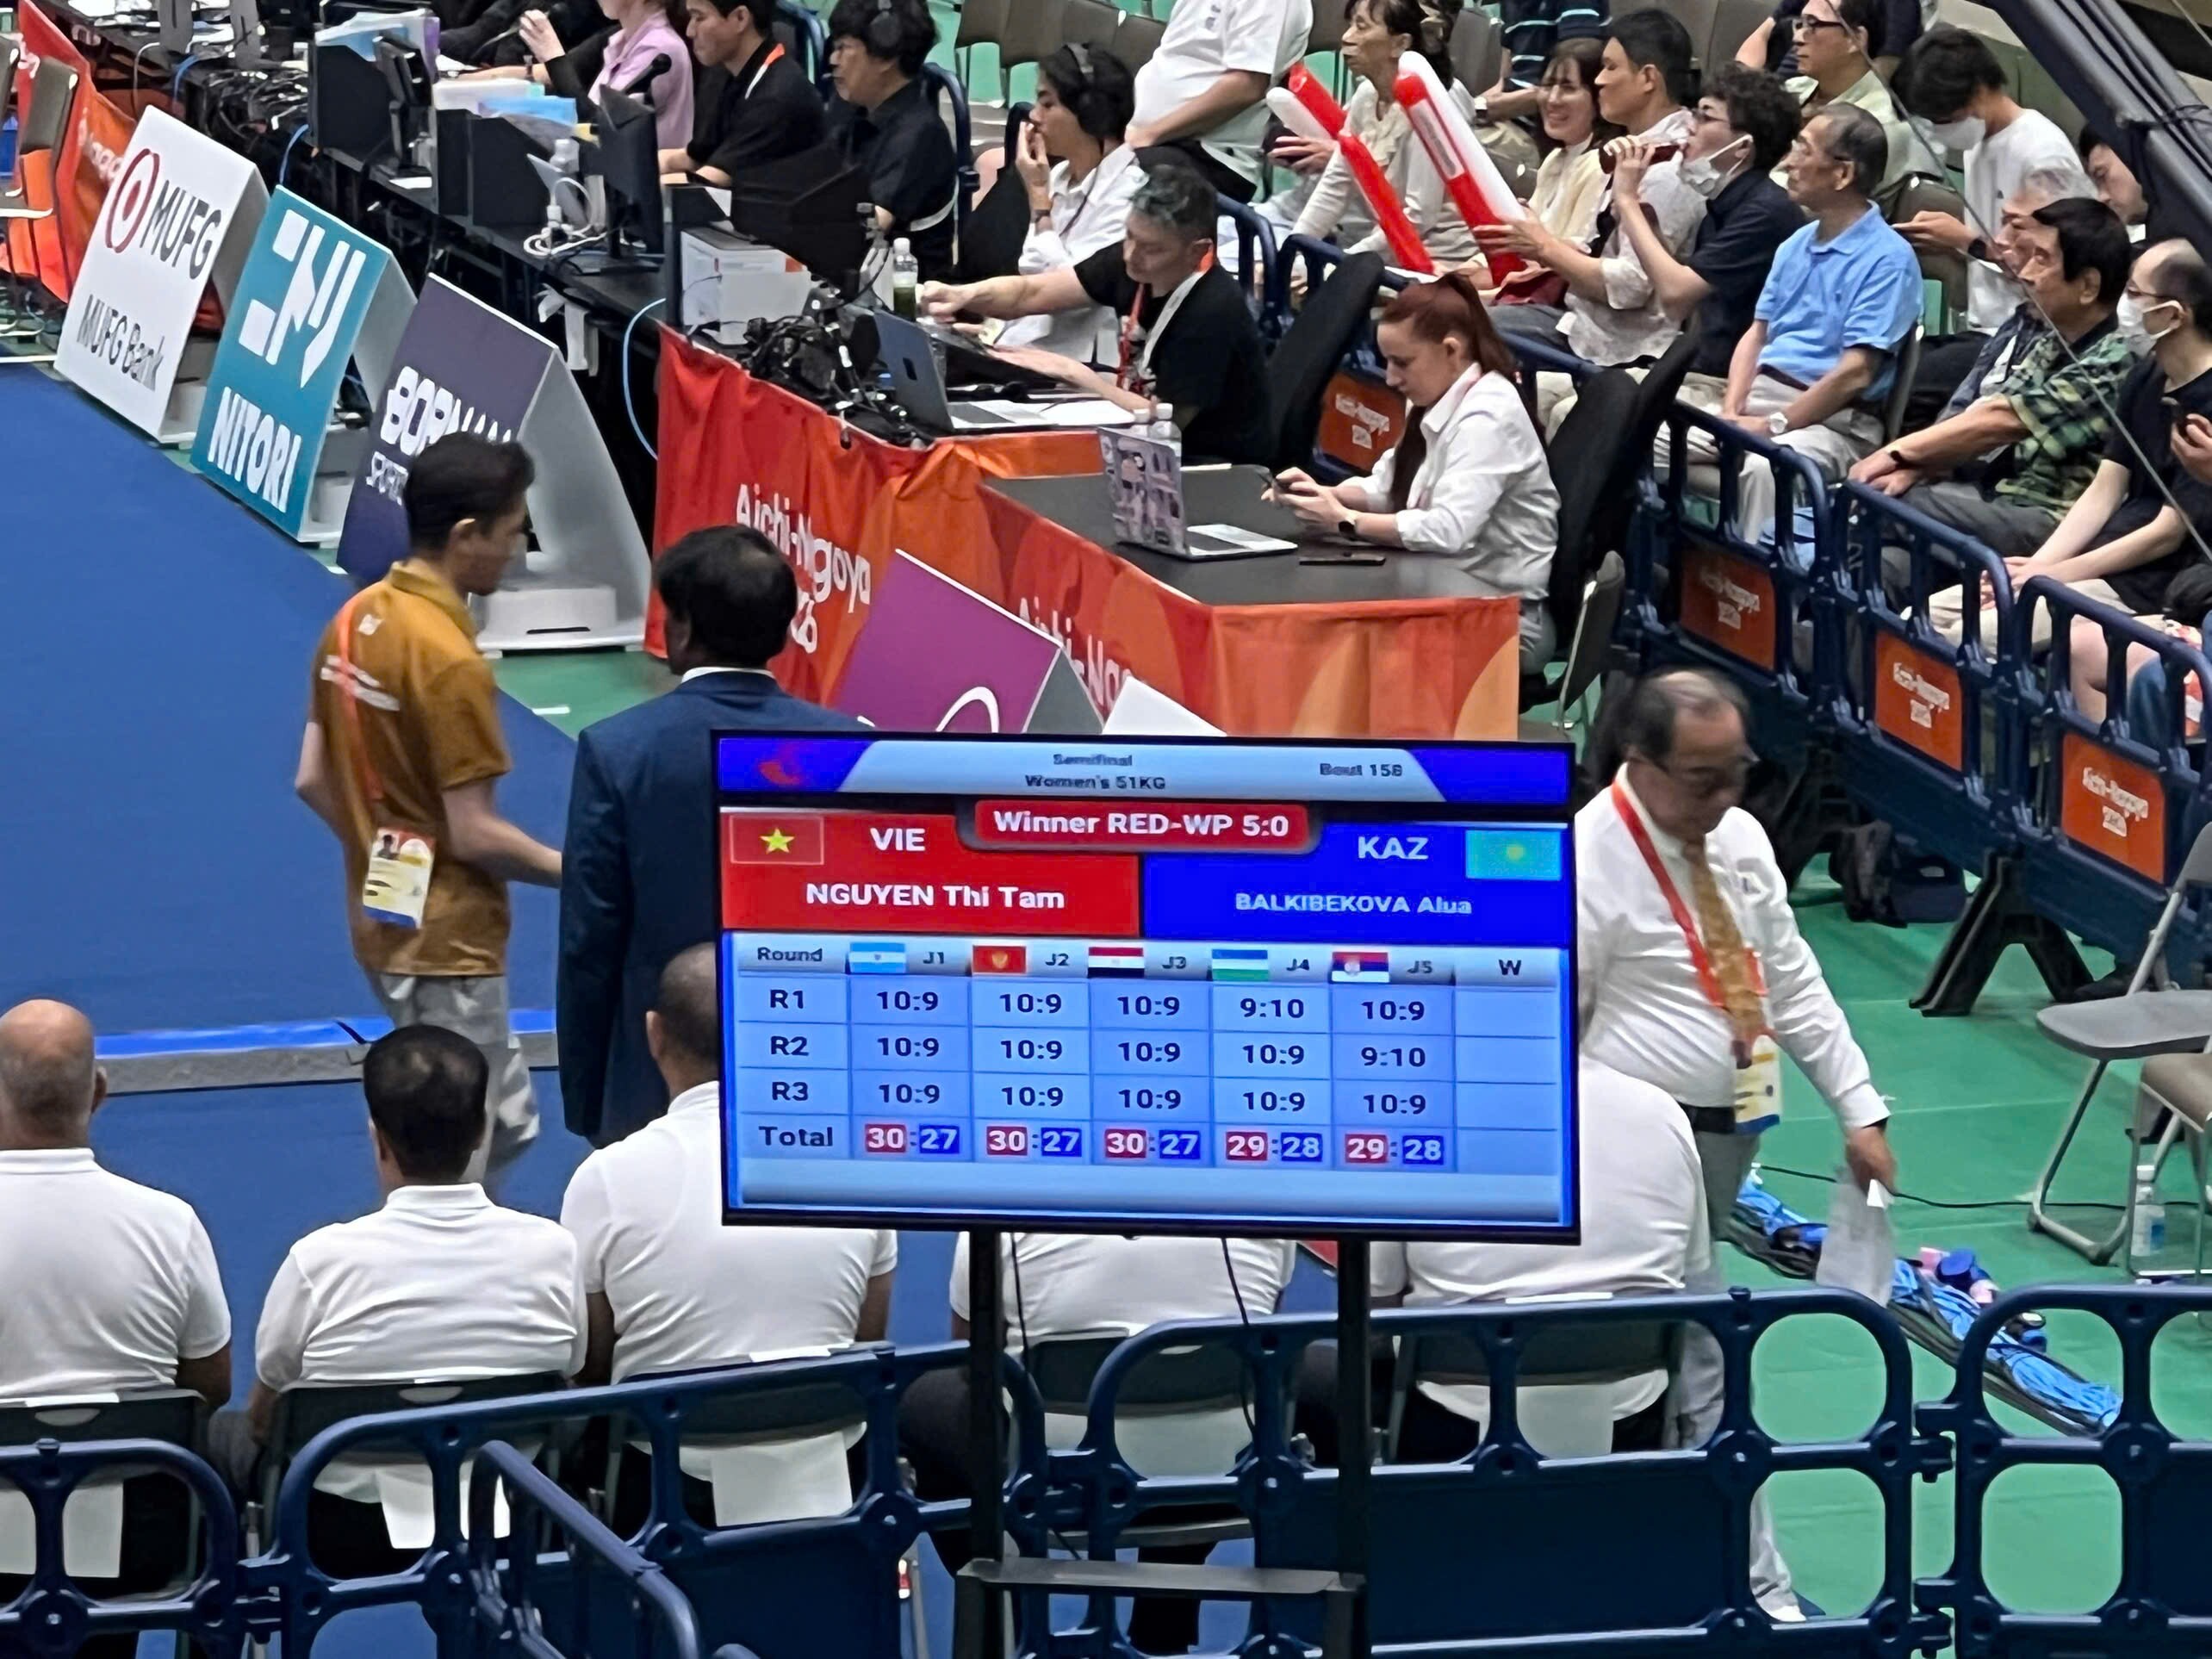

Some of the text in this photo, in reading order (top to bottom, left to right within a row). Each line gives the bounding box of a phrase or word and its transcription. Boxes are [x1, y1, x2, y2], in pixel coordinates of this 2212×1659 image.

[140, 179, 221, 279] MUFG
[77, 294, 127, 366] MUFG
[208, 386, 301, 513] NITORI
[1025, 774, 1165, 790] Women's 51KG
[1370, 763, 1402, 777] 158
[993, 811, 1289, 837] Winner RED-WP 5:0
[870, 827, 926, 852] VIE
[1358, 836, 1429, 861] KAZ
[806, 883, 1065, 909] NGUYEN Thi Tam
[1235, 892, 1472, 915] BALKIBEKOVA Alua
[757, 946, 1522, 975] Round J1 J2 J3 J4 J5 W
[769, 989, 1425, 1021] R1 10:9 10:9 10:9 9:10 10:9
[770, 1035, 1426, 1067] R2 10:9 10:9 10:9 10:9 9:10
[772, 1081, 1426, 1115] R3 10:9 10:9 10:9 10:9 10:9
[758, 1126, 833, 1147] Total
